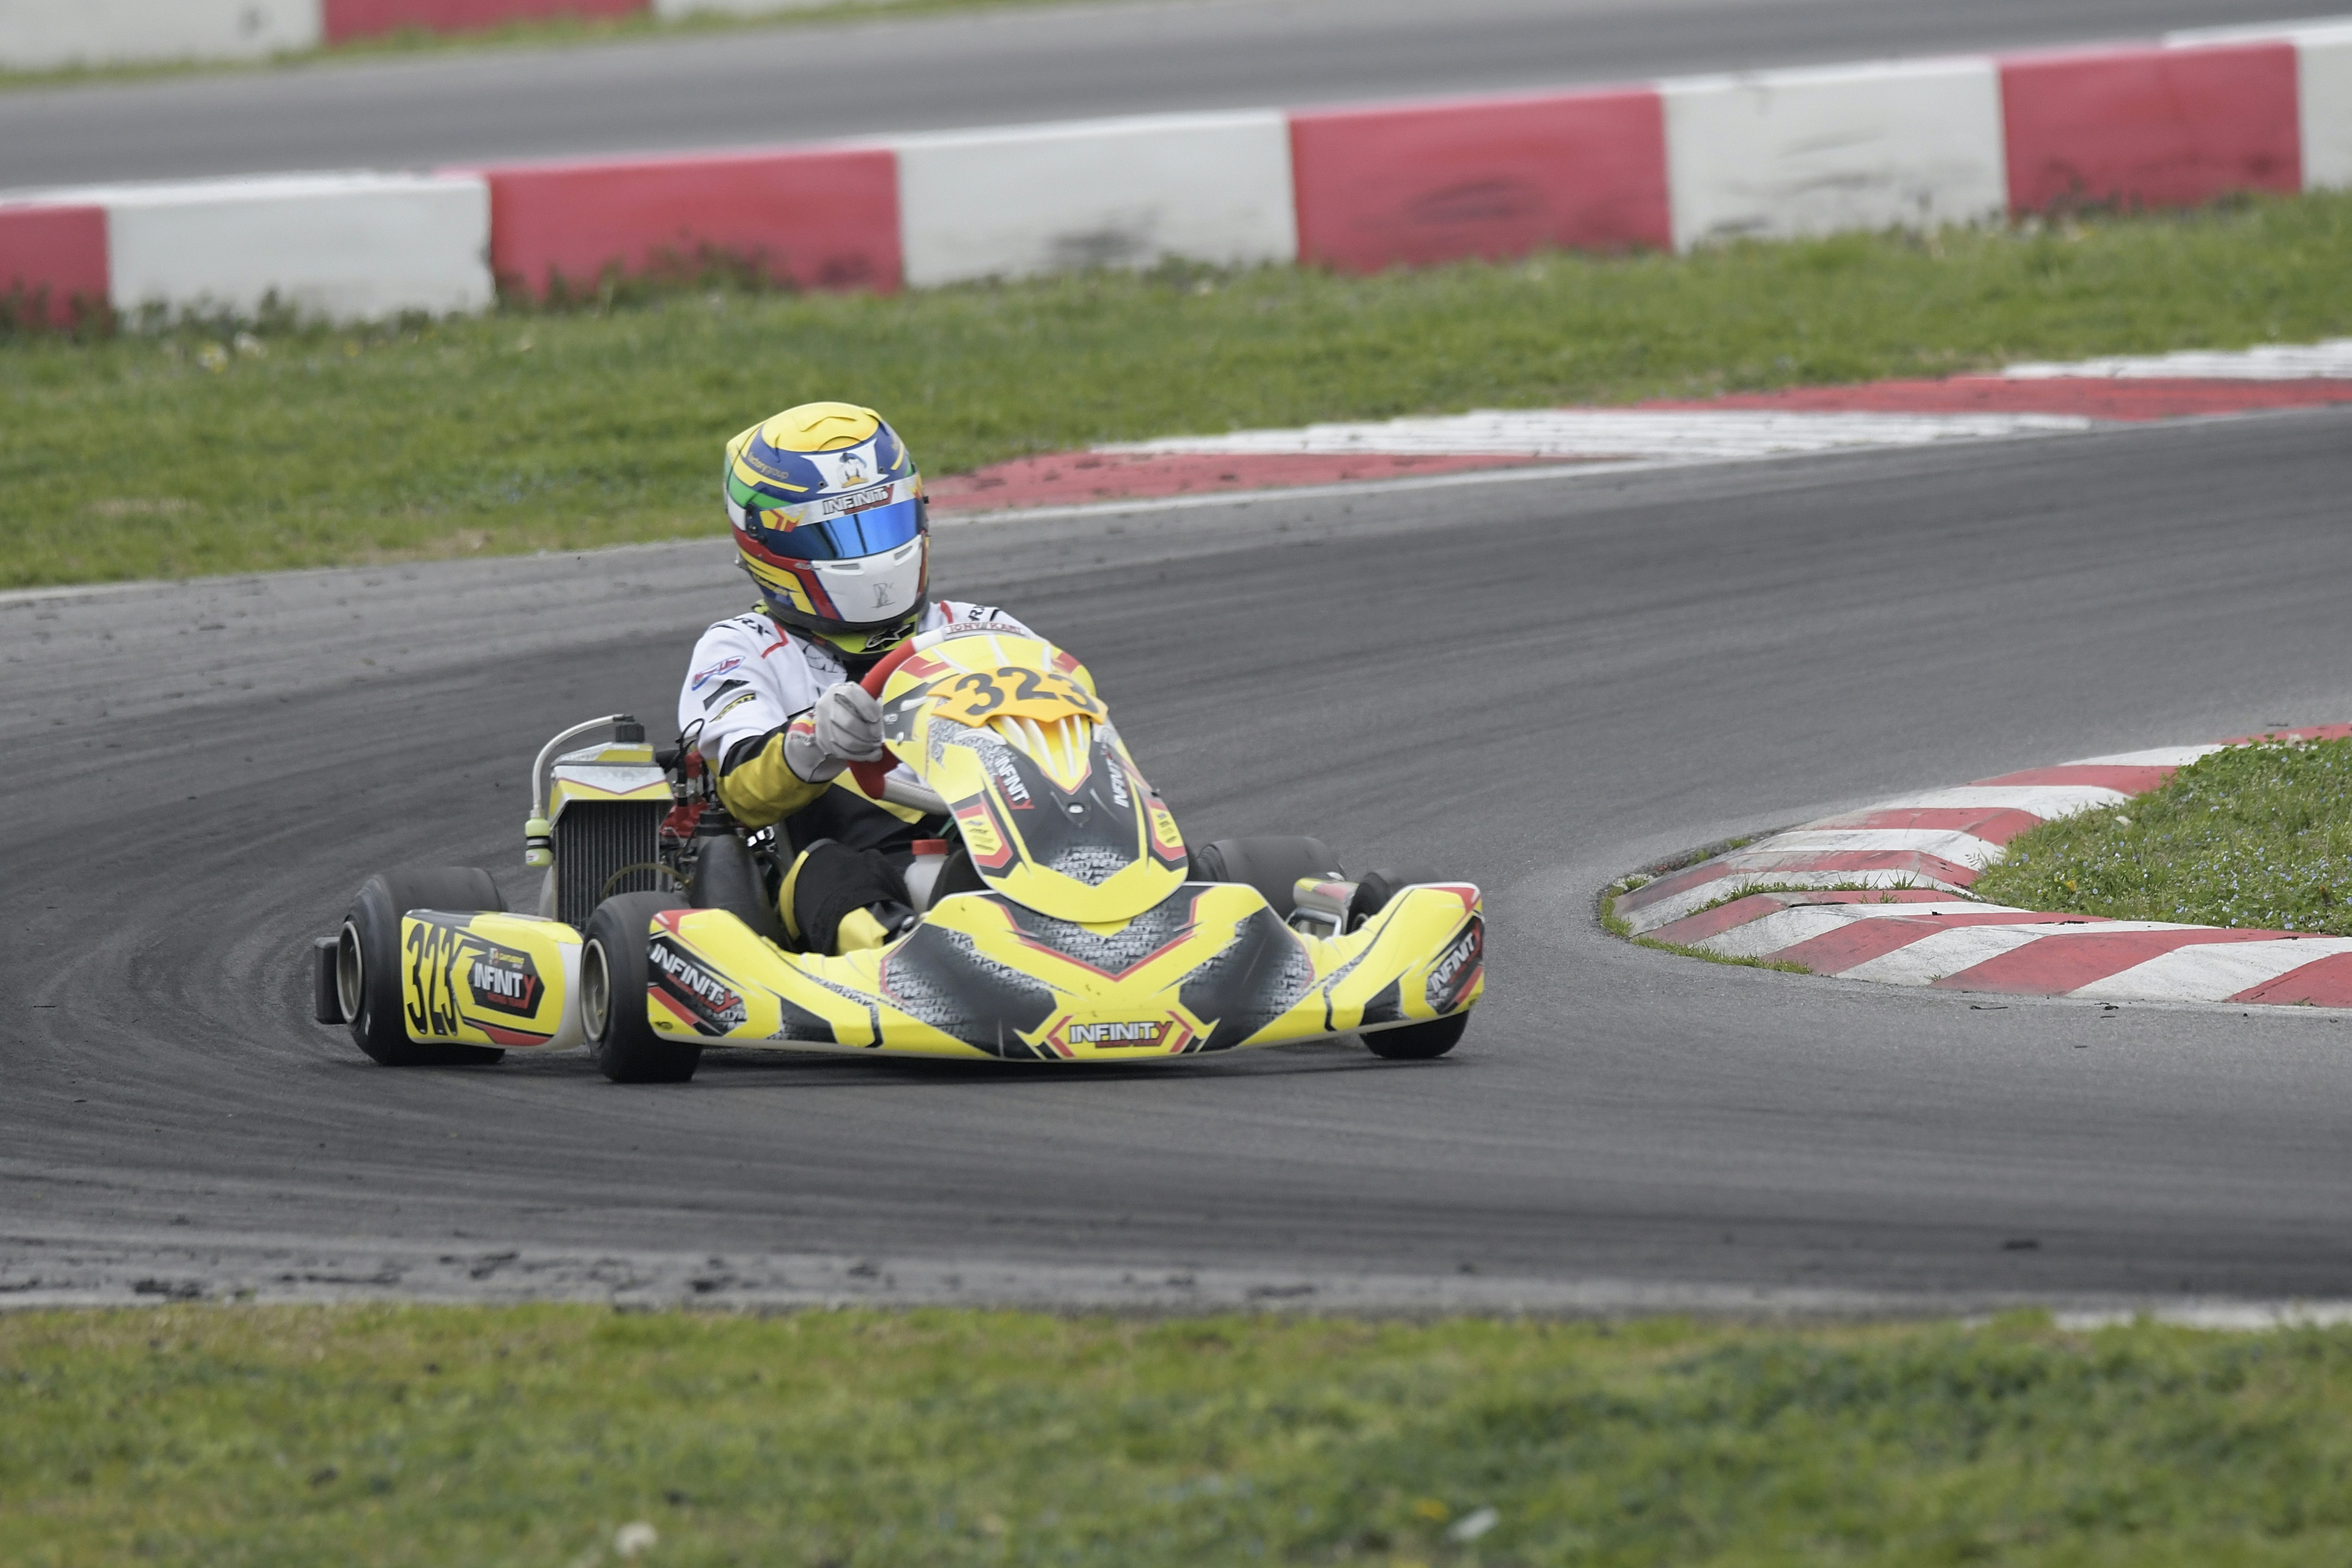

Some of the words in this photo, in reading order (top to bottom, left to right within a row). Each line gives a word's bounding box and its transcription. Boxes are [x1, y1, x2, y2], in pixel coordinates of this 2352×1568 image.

[823, 483, 894, 515] INFINITY
[955, 666, 1099, 716] 323
[994, 756, 1034, 810] INFINITY
[406, 923, 458, 1037] 323
[474, 962, 536, 1010] INFINITY
[649, 943, 740, 1013] INFINITY
[1069, 1021, 1173, 1048] INFINITY
